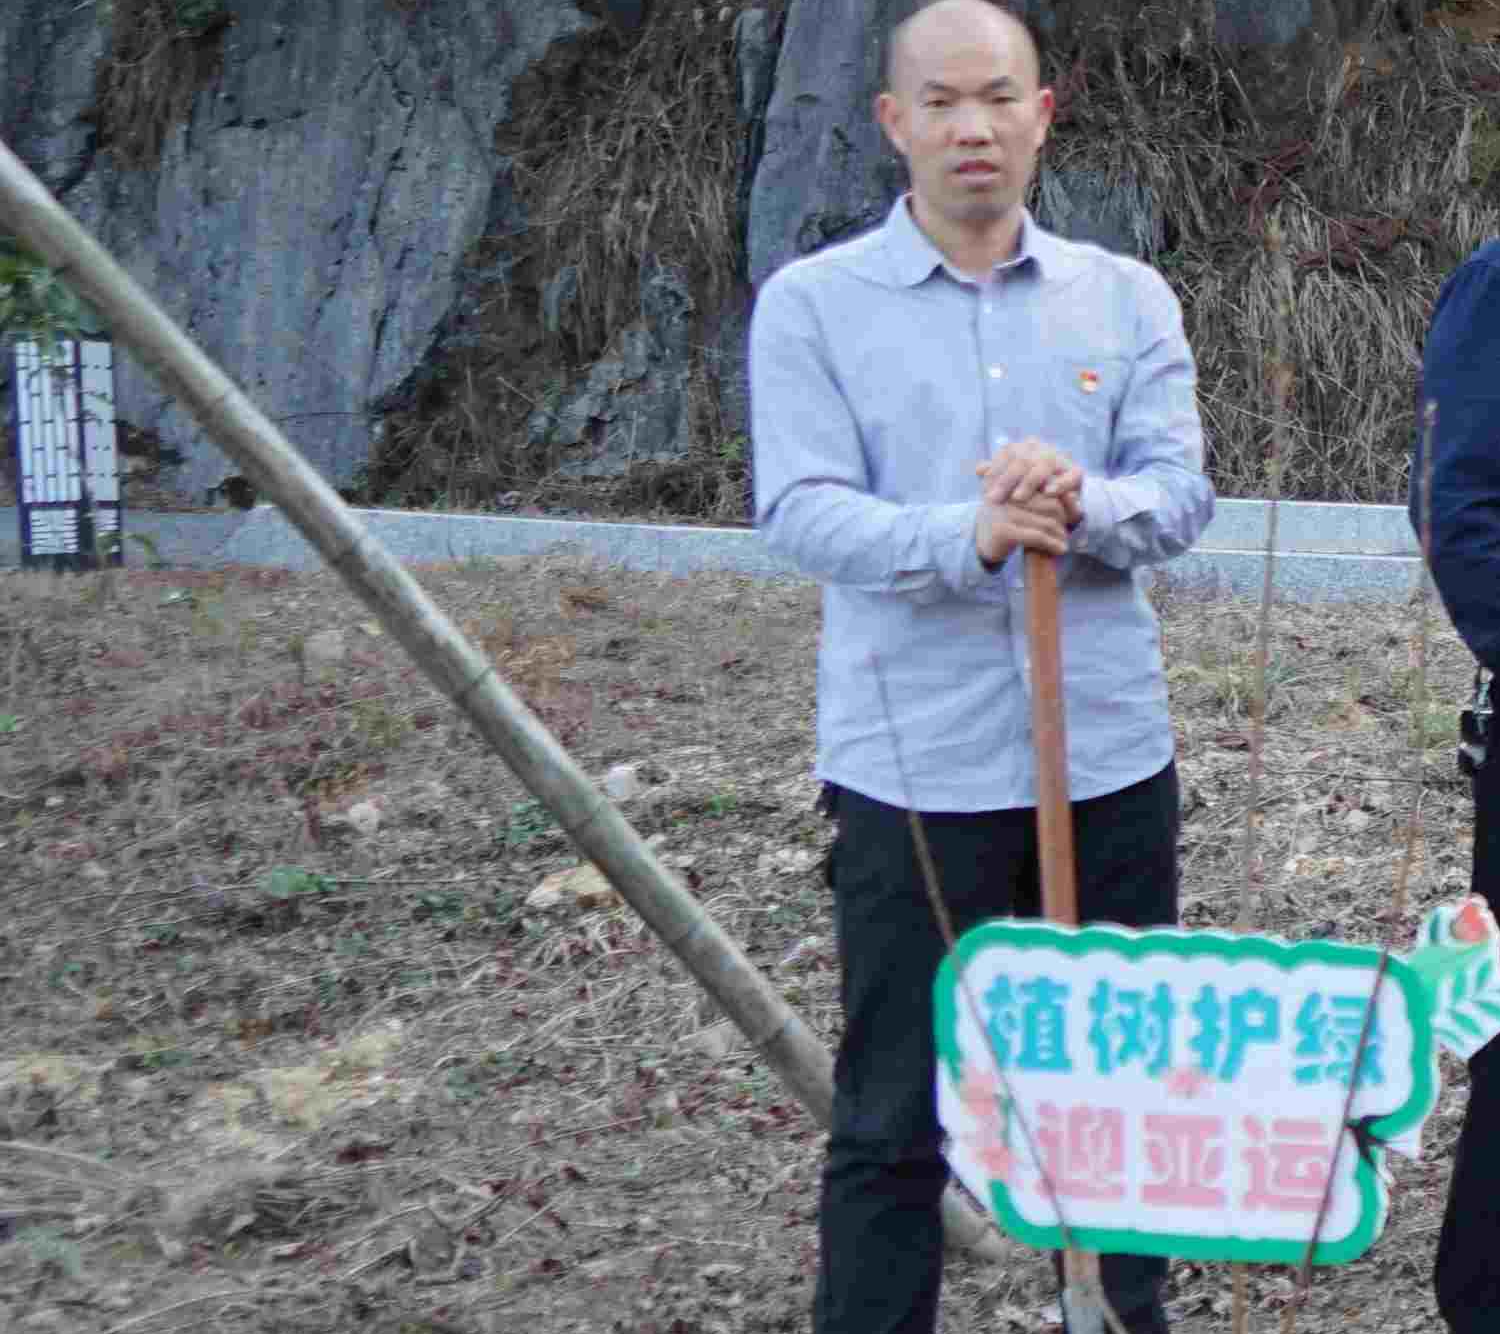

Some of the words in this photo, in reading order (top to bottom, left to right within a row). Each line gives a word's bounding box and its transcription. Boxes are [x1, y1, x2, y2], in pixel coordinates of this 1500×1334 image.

[983, 974, 1387, 1086] 植树护绿
[1036, 1101, 1330, 1213] 迎亚运
